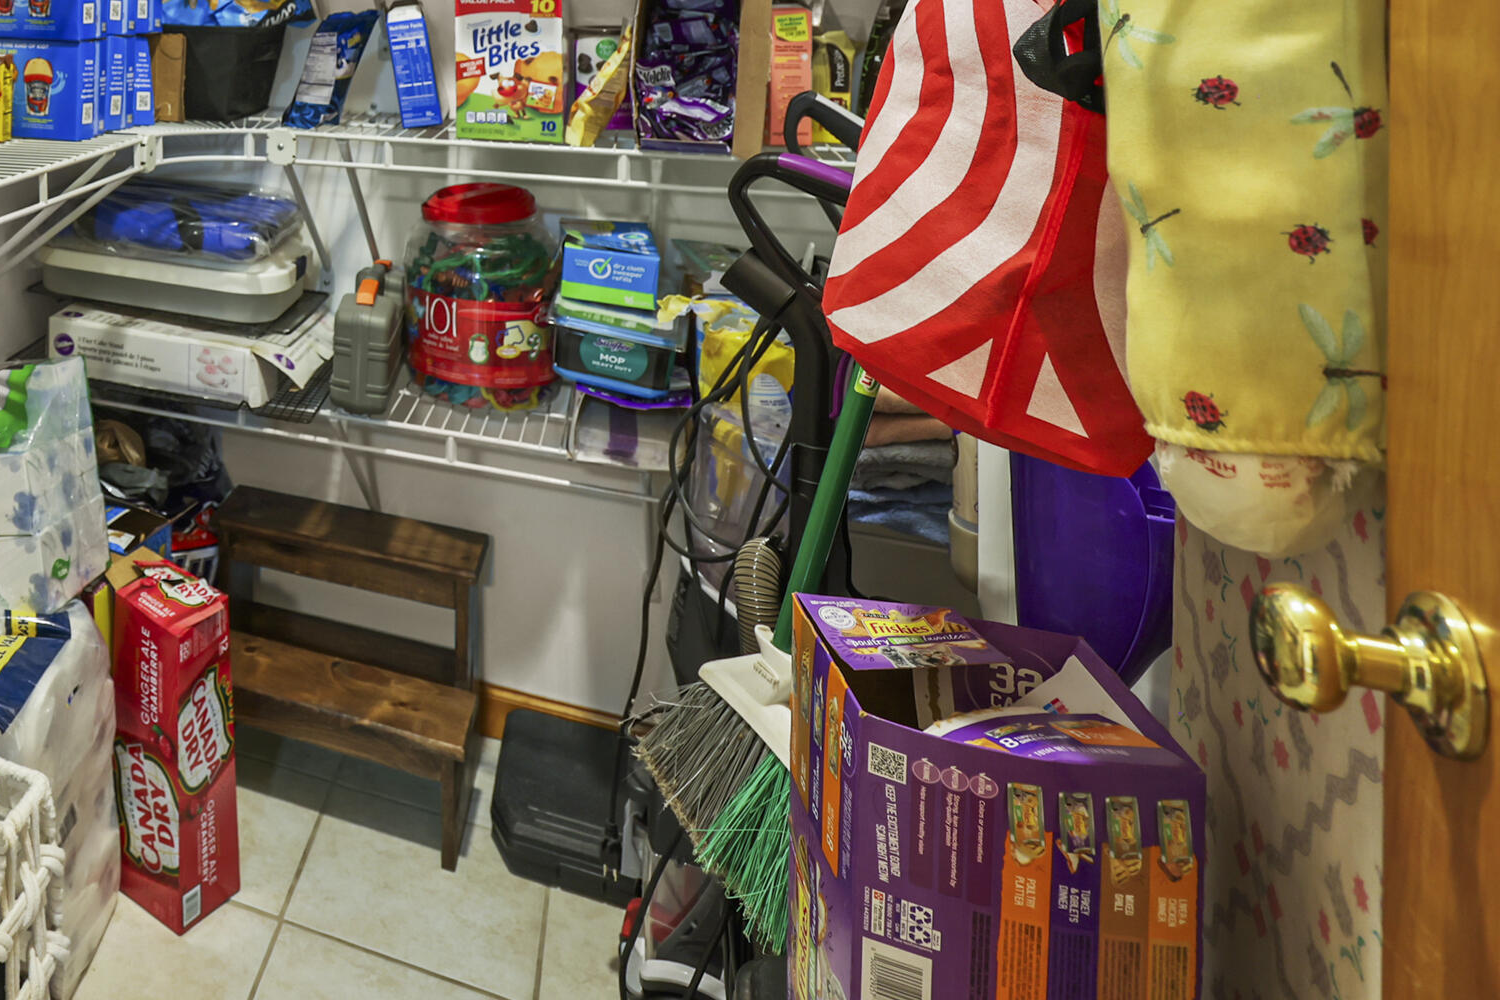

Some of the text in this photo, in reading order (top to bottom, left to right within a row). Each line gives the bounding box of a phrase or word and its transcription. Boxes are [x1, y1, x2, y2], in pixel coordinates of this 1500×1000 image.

[472, 19, 523, 55] Little
[488, 40, 541, 68] Bites
[540, 120, 557, 133] 10
[611, 270, 644, 280] sweeper
[611, 275, 633, 284] refills
[612, 263, 646, 274] dry cloth
[425, 294, 458, 339] 101
[599, 352, 627, 365] MOP
[869, 621, 931, 635] Friskies
[219, 634, 229, 656] 12
[850, 637, 891, 648] poultry
[140, 626, 150, 725] GINGER ALE
[149, 641, 159, 724] CRANBERRY
[988, 662, 1043, 699] 32
[181, 718, 204, 772] DRY
[192, 678, 222, 784] CANADA
[999, 736, 1019, 749] 8
[884, 783, 897, 803] KEEP
[126, 743, 162, 875] CANADA
[147, 779, 175, 849] DRY
[206, 799, 218, 886] GINGER ALE
[875, 823, 887, 843] SCAN
[976, 825, 984, 864] preservatives
[200, 812, 210, 884] CRANBERRY
[1013, 875, 1025, 907] PLATTER
[1025, 877, 1037, 910] POULTRY
[1057, 884, 1069, 911] DINNER
[1080, 889, 1092, 917] TURKEY
[1114, 892, 1125, 913] GRILL
[1124, 893, 1135, 917] MIXED
[1068, 894, 1080, 924] GIBLETS
[1157, 896, 1168, 923] DINNER
